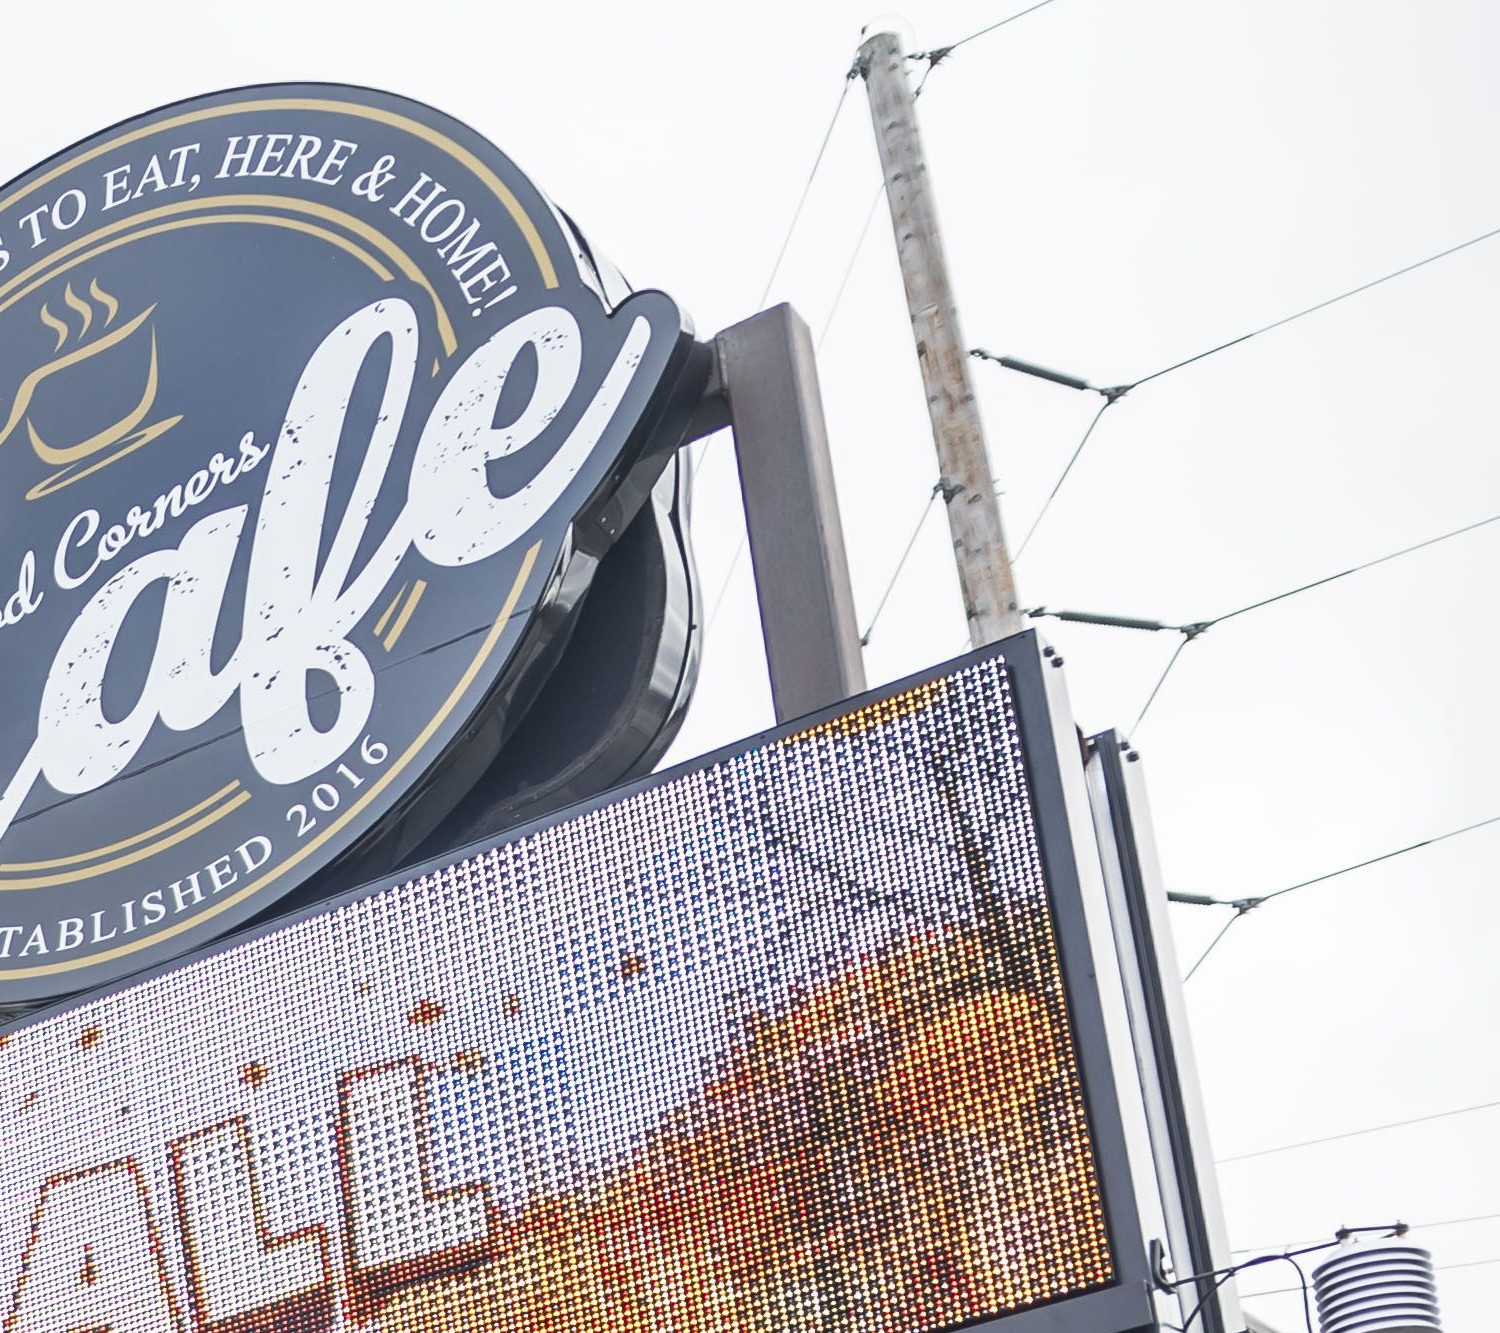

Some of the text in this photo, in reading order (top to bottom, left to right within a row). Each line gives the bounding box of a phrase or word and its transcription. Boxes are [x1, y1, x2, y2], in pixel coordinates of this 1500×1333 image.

[18, 188, 87, 249] TO
[100, 142, 201, 212] EAT,
[213, 133, 358, 186] HERE
[350, 154, 397, 203] &
[388, 171, 518, 318] HOME!
[53, 430, 270, 585] Corners
[285, 733, 389, 838] 2016
